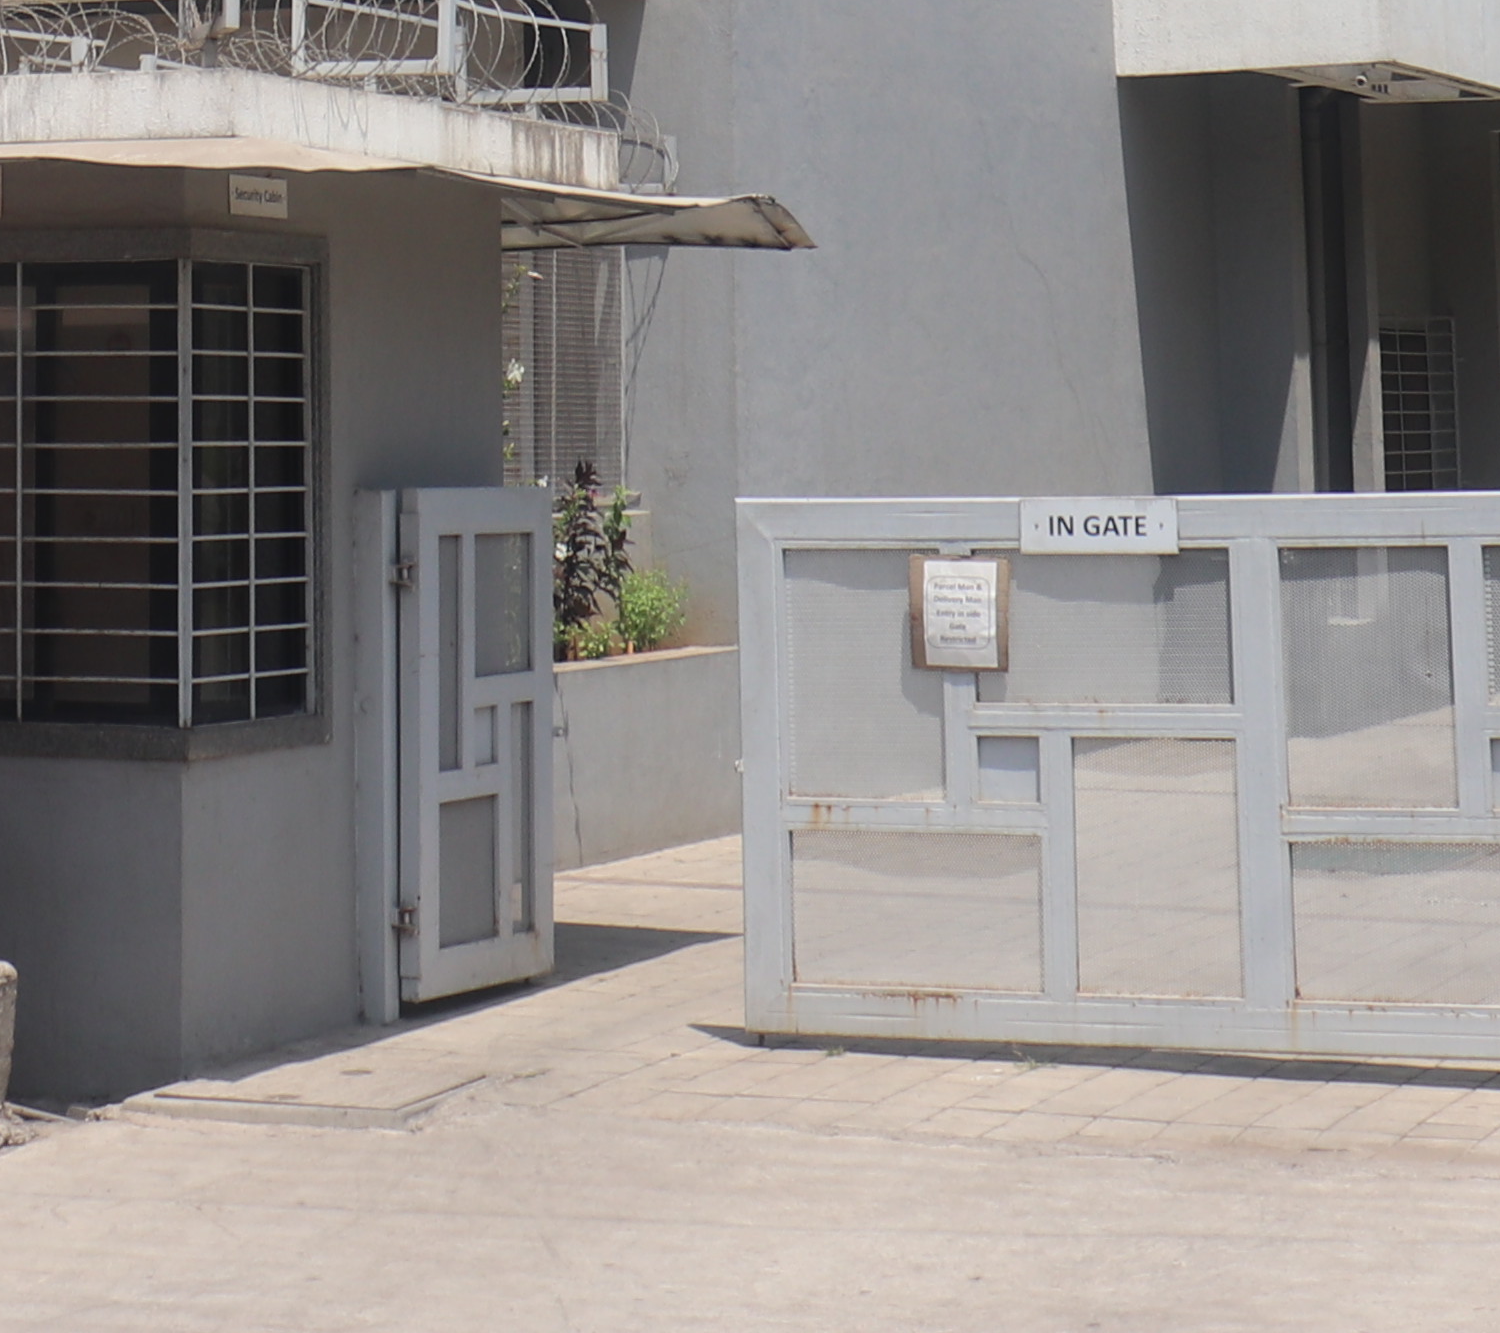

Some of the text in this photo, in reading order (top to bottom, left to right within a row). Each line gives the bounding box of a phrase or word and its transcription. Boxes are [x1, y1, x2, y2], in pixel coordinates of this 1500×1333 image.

[234, 187, 283, 205] Security Cabin
[1049, 515, 1147, 537] IN GATE
